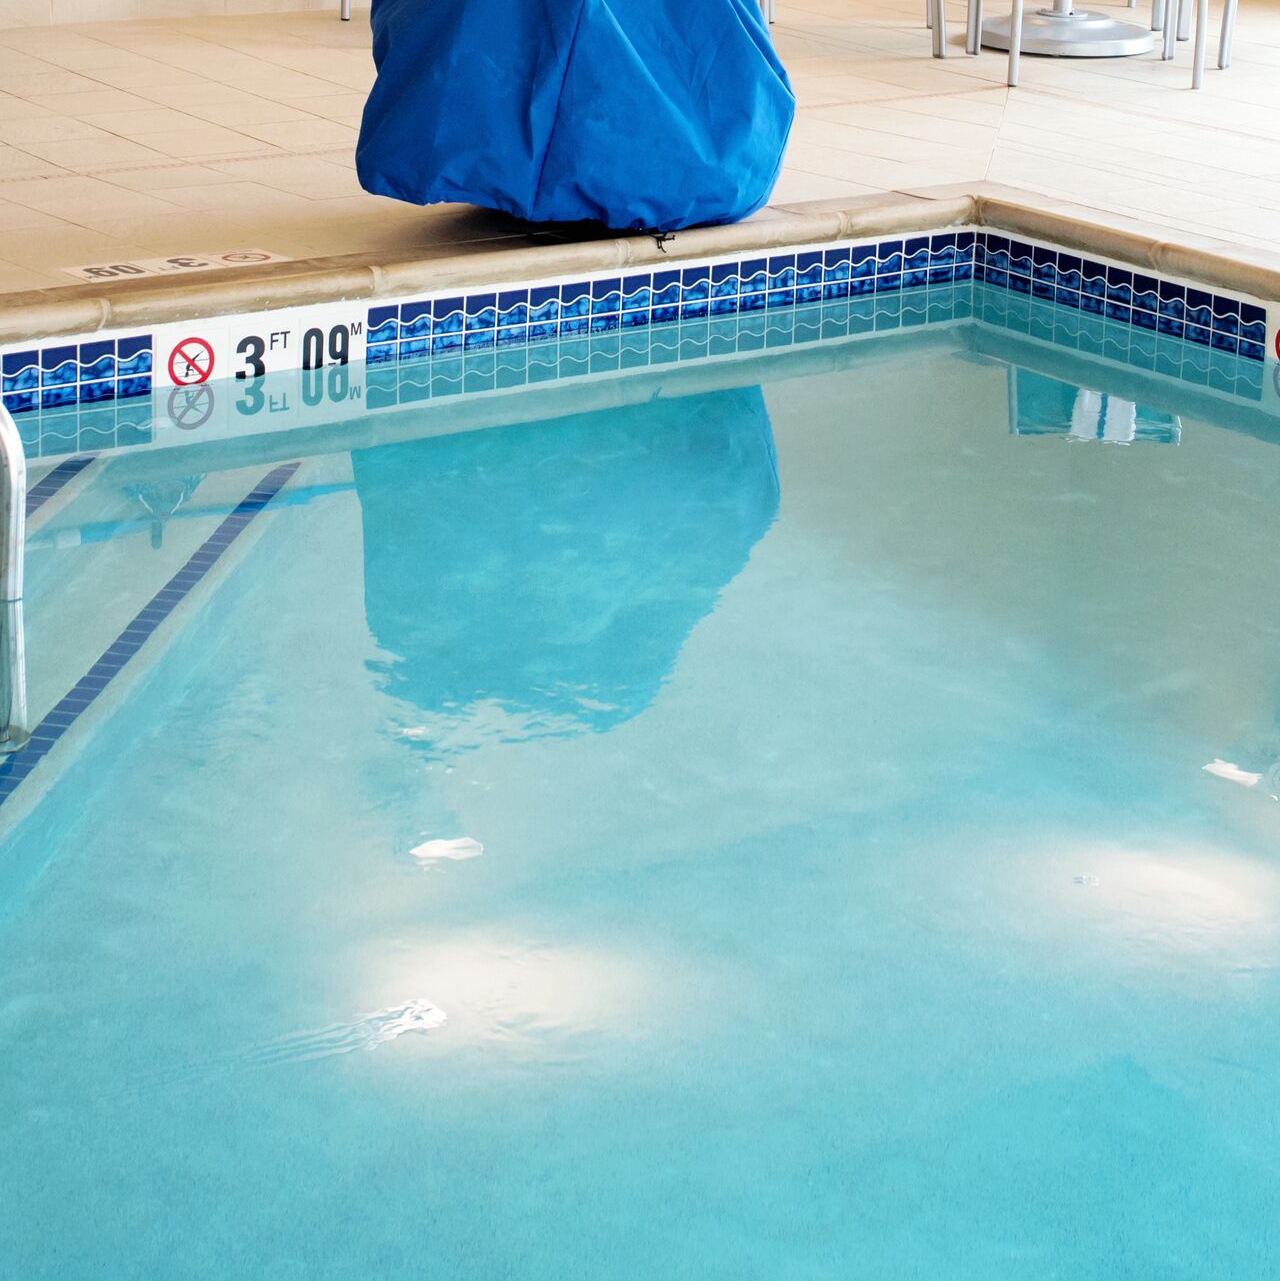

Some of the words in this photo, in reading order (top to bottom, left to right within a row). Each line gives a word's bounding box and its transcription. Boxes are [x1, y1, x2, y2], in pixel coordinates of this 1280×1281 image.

[166, 258, 208, 268] 3
[236, 336, 265, 379] 3
[270, 330, 290, 350] FT
